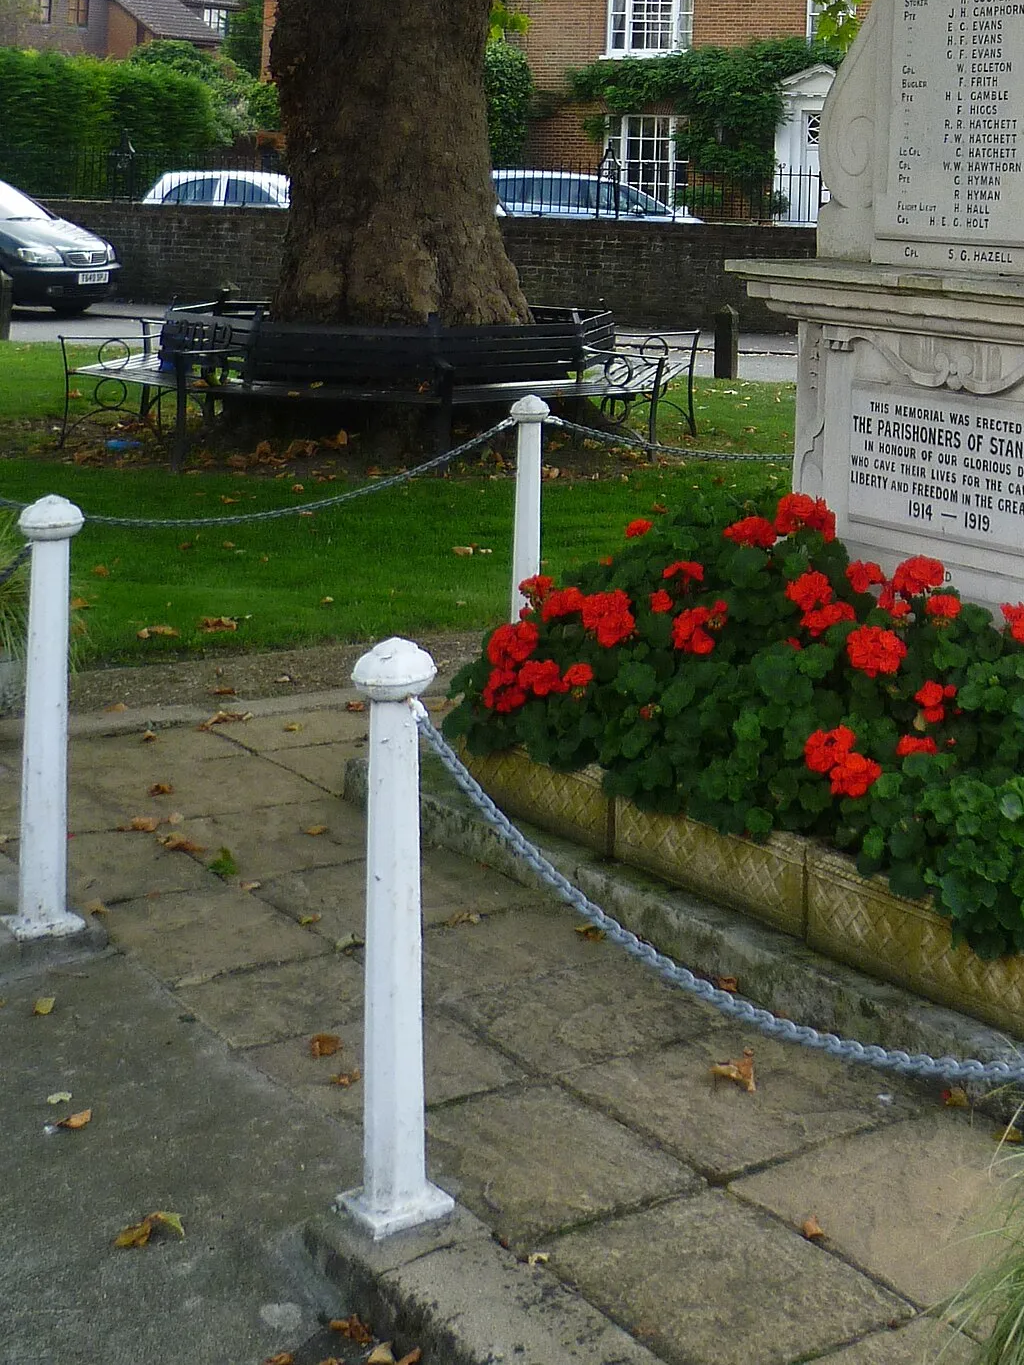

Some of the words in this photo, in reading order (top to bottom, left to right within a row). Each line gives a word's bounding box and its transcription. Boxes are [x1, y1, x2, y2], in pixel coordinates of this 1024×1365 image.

[973, 4, 1024, 17] CAMPHORN
[972, 20, 1002, 31] EVANS
[972, 34, 1002, 45] EVANS
[971, 48, 1002, 59] EVANS
[971, 62, 1012, 73] EGLETON
[971, 76, 998, 87] FRITH
[970, 91, 1009, 101] GAMBLE
[969, 119, 1017, 129] HATCHETT
[969, 133, 1017, 144] HATCHETT
[969, 147, 1017, 158] HATCHETT
[968, 161, 1022, 172] HAWTHORN
[967, 175, 1001, 186] HYMAN
[967, 189, 1001, 200] HYMAN
[966, 204, 990, 214] HALL
[966, 218, 989, 228] HOLT
[973, 251, 1012, 263] HAZELL
[870, 401, 889, 414] THIS
[895, 405, 945, 422] MEMORIAL
[949, 412, 970, 426] WAS
[976, 416, 1022, 434] ERECTED
[853, 415, 872, 434] THE
[877, 419, 961, 449] PARISHONERS
[967, 433, 983, 452] OF
[864, 440, 874, 452] IN
[879, 442, 916, 459] HONOUR
[921, 450, 933, 462] OF
[938, 453, 957, 466] OUR
[963, 457, 1011, 475] GLORIOUS
[851, 454, 869, 468] WHO
[873, 458, 896, 472] GAVE
[900, 463, 926, 478] THEIR
[931, 468, 957, 483] LIVES
[962, 474, 980, 488] FOR
[985, 478, 1002, 492] THE
[850, 470, 888, 490] LIBERTY
[891, 480, 909, 493] AND
[912, 481, 958, 503] FREEDOM
[962, 493, 971, 506] IN
[975, 494, 993, 509] THE
[908, 499, 932, 521] 1914
